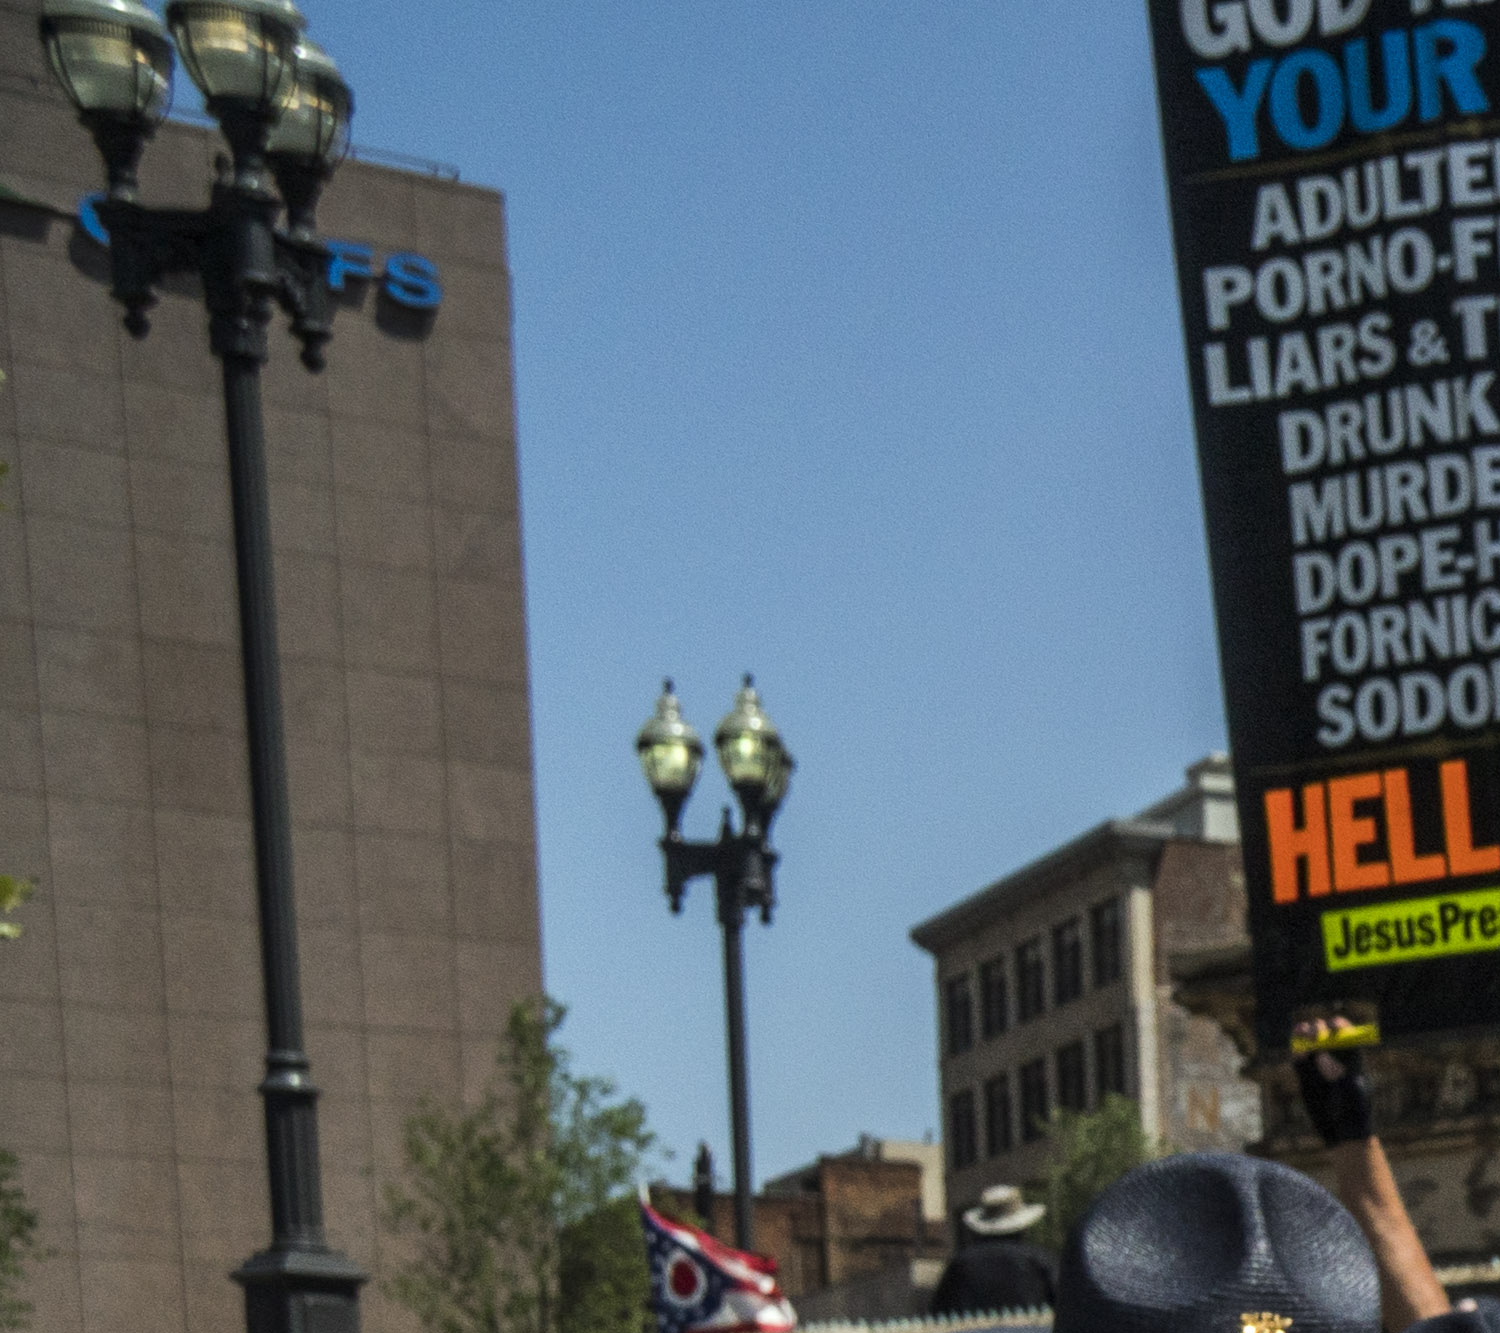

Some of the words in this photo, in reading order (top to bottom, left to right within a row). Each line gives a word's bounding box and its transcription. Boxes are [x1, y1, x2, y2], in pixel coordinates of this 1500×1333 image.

[1195, 18, 1489, 162] YOUR
[1203, 313, 1396, 407] LIARS
[1406, 321, 1450, 369] &
